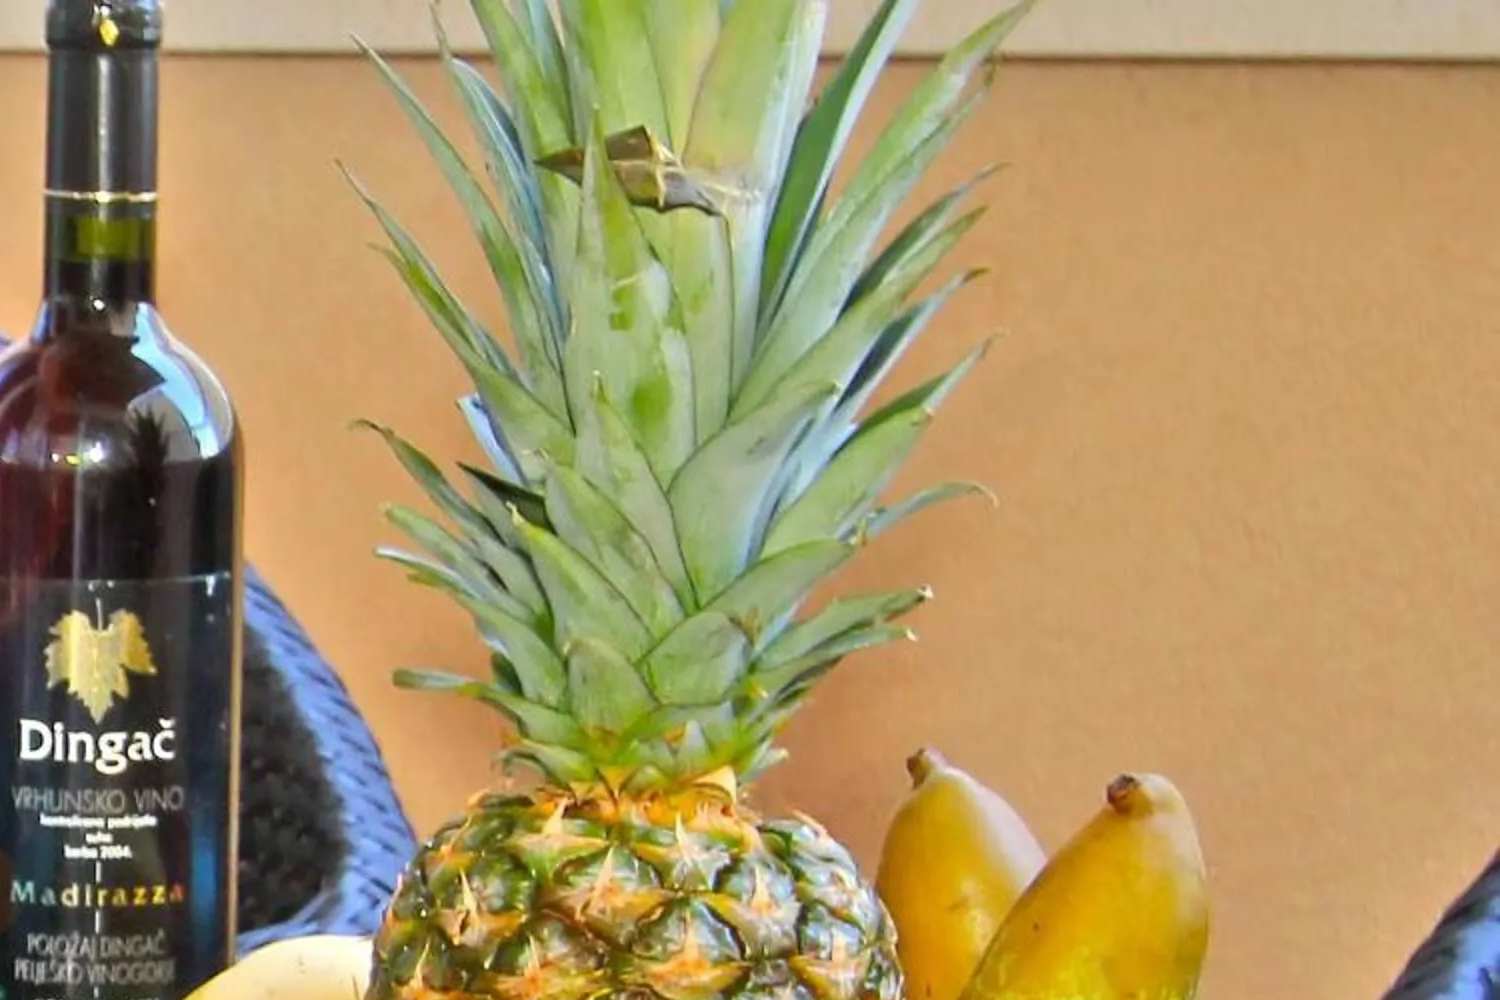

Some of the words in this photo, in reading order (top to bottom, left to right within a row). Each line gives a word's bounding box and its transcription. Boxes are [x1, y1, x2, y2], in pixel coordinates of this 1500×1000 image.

[19, 718, 177, 775] Dingač
[133, 785, 185, 812] VINO
[10, 880, 185, 908] Madirazza
